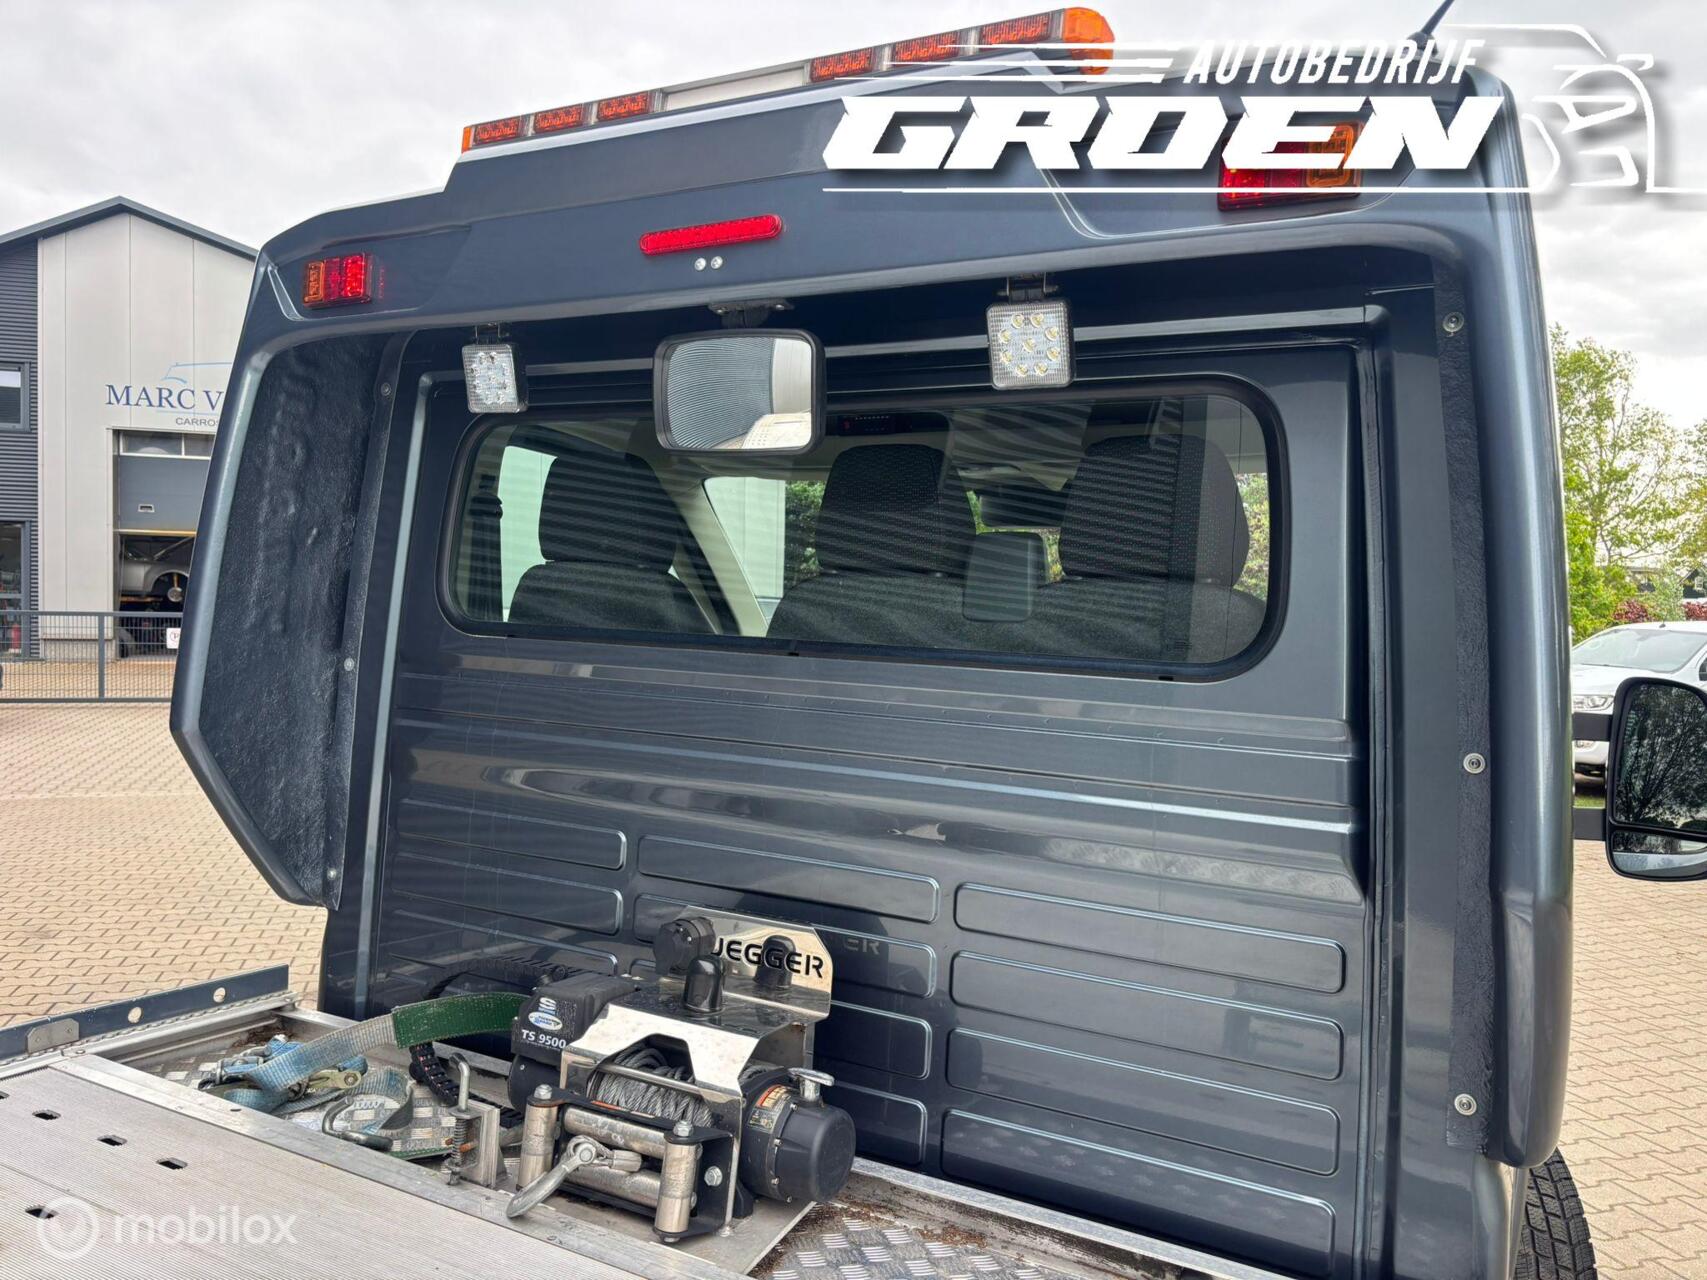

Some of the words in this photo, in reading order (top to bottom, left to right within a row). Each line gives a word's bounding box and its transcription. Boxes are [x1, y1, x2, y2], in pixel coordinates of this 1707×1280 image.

[105, 384, 196, 410] MARC
[711, 937, 824, 978] JEGGER
[521, 1029, 536, 1041] TS
[538, 1033, 567, 1049] 9500
